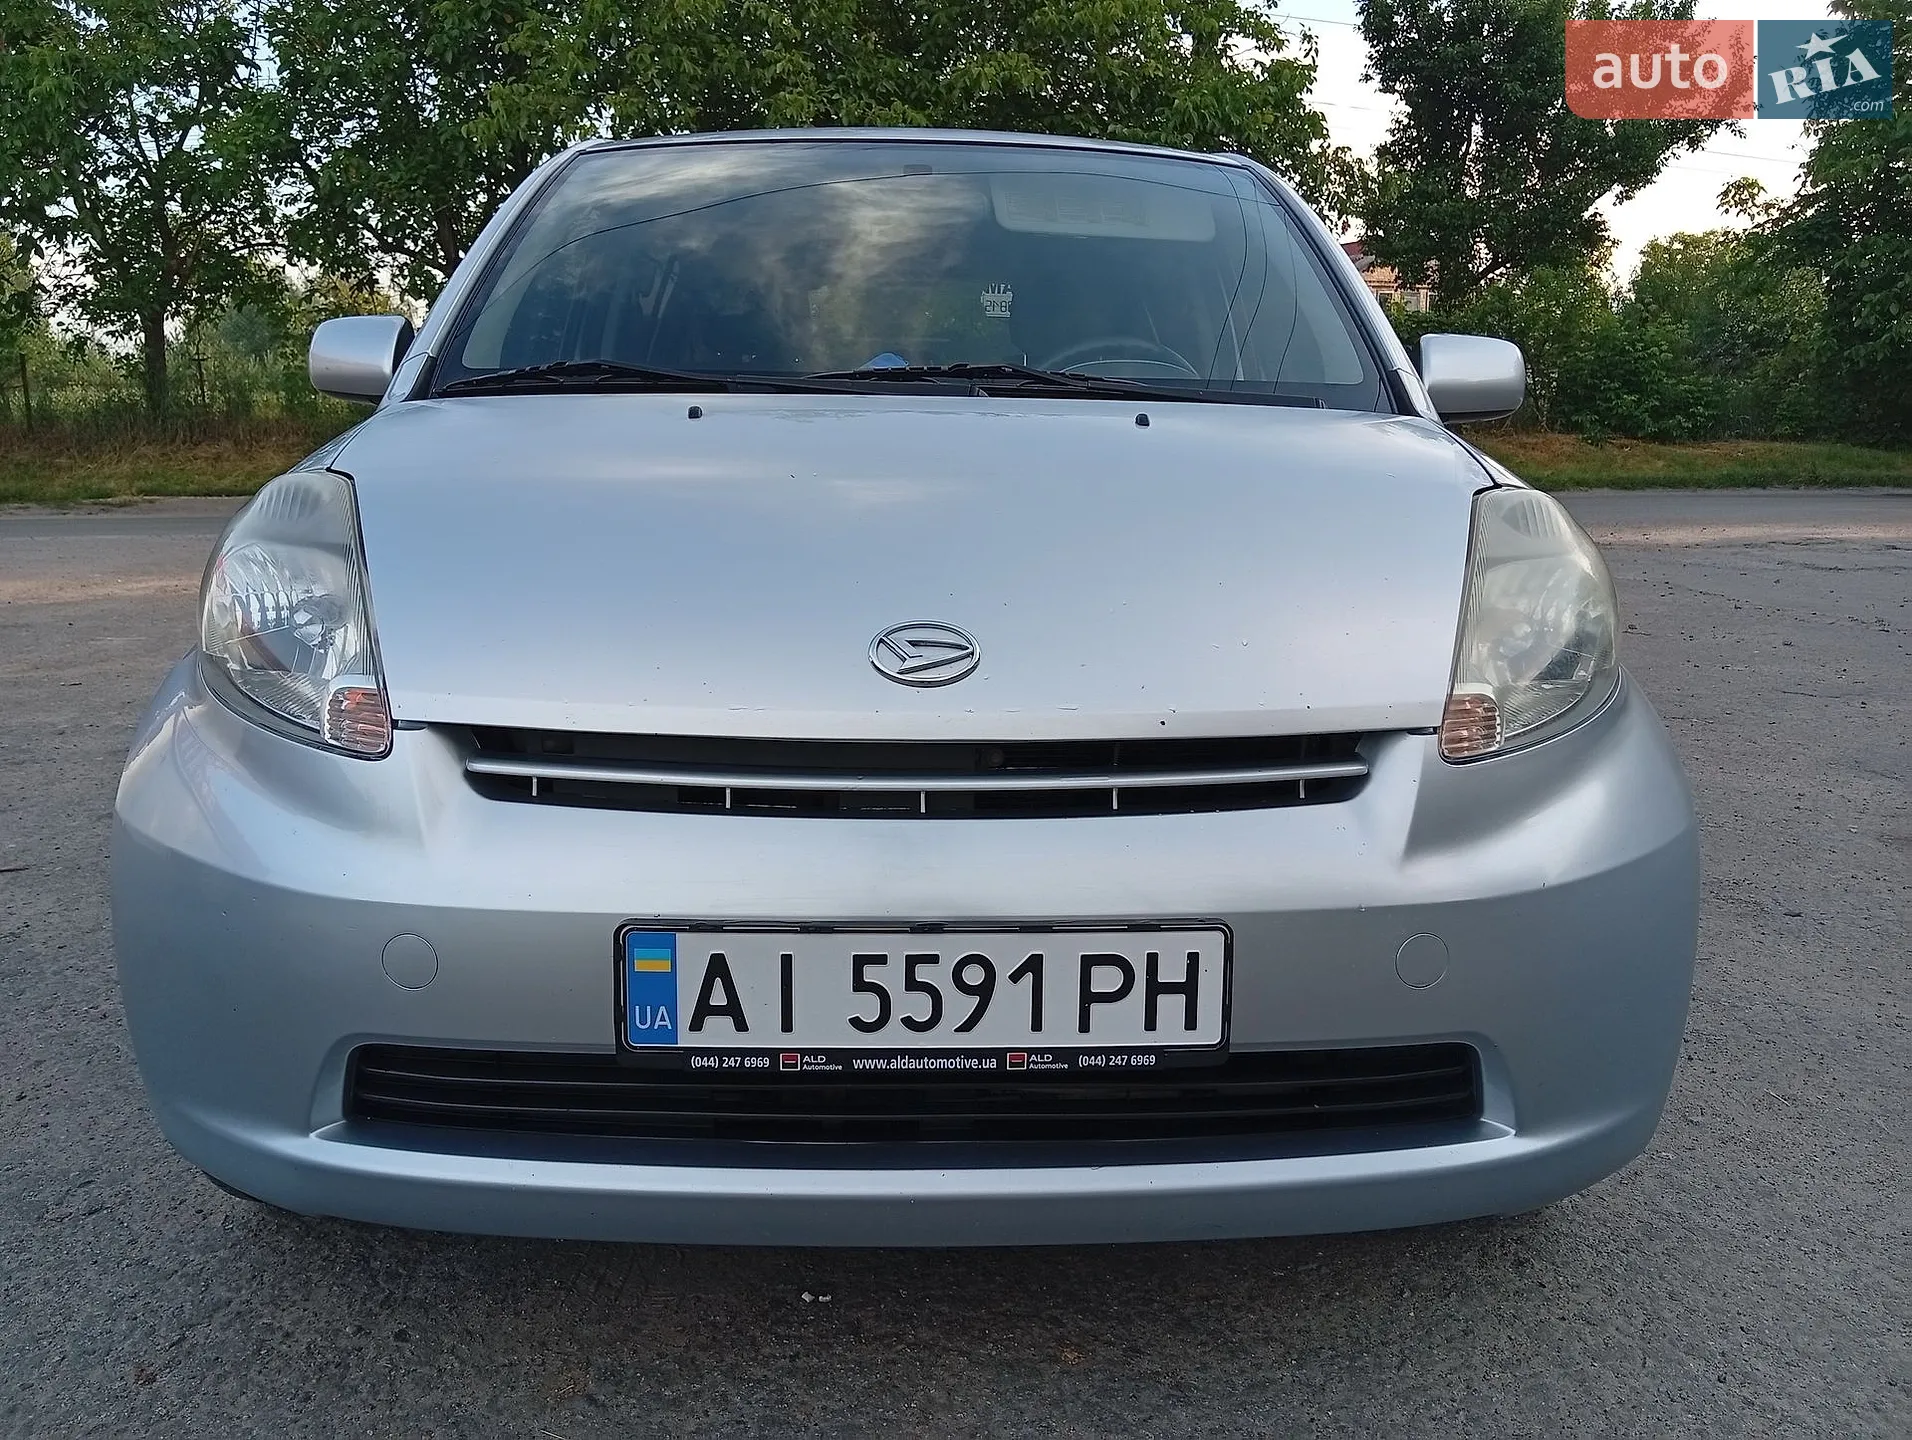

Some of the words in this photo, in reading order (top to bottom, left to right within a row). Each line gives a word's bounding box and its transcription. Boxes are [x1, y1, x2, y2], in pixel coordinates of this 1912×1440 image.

[687, 951, 796, 1033] AI
[847, 950, 1044, 1034] 5591
[1078, 951, 1201, 1034] PH
[634, 1004, 673, 1031] UA
[690, 1055, 719, 1069] (044)
[722, 1056, 741, 1068] 247
[744, 1056, 770, 1068] 6969
[802, 1055, 826, 1064] ALD
[852, 1055, 997, 1070] www.aldautomotive.ua
[1029, 1054, 1053, 1062] ALD
[1078, 1054, 1106, 1068] (044)
[1108, 1055, 1128, 1066] 247
[1130, 1054, 1156, 1066] 6969
[802, 1063, 843, 1071] Automotive
[1029, 1062, 1069, 1070] Automotive
